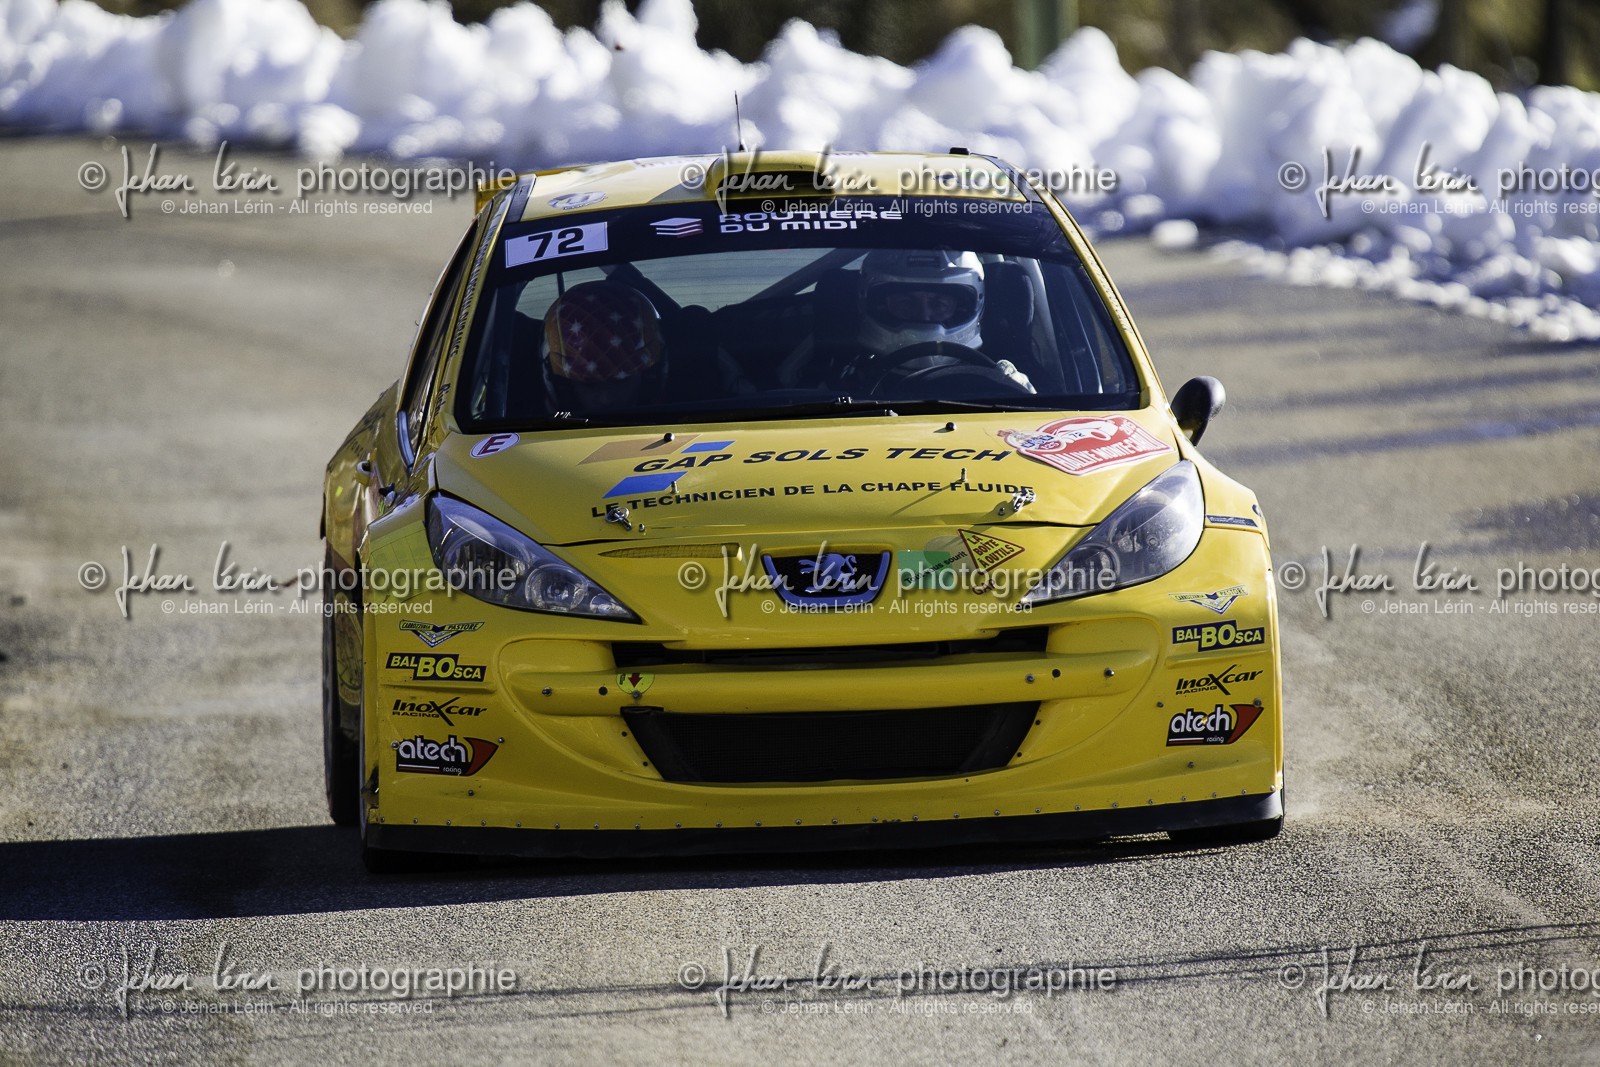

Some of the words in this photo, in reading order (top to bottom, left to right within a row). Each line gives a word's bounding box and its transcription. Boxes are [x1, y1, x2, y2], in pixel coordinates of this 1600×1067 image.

[719, 210, 903, 223] ROUTIERE
[720, 222, 770, 233] DU
[781, 220, 858, 231] MIDI
[527, 227, 585, 259] 72
[477, 434, 512, 456] E
[633, 453, 733, 473] GAP
[743, 448, 868, 464] SOLS
[886, 447, 1011, 462] TECH
[627, 487, 776, 510] TECHNICIEN
[784, 485, 815, 496] DE
[824, 483, 854, 494] LA
[862, 482, 943, 493] CHAPE
[967, 534, 983, 545] LA
[985, 544, 1015, 564] OUTILS
[1175, 624, 1262, 648] BALBOSCA
[390, 655, 482, 679] BALBOSCA
[1176, 685, 1218, 695] RACING
[391, 711, 440, 719] RACING
[1171, 706, 1230, 733] atech
[399, 737, 467, 762] atech
[1206, 736, 1225, 744] racing
[443, 765, 462, 775] racing
